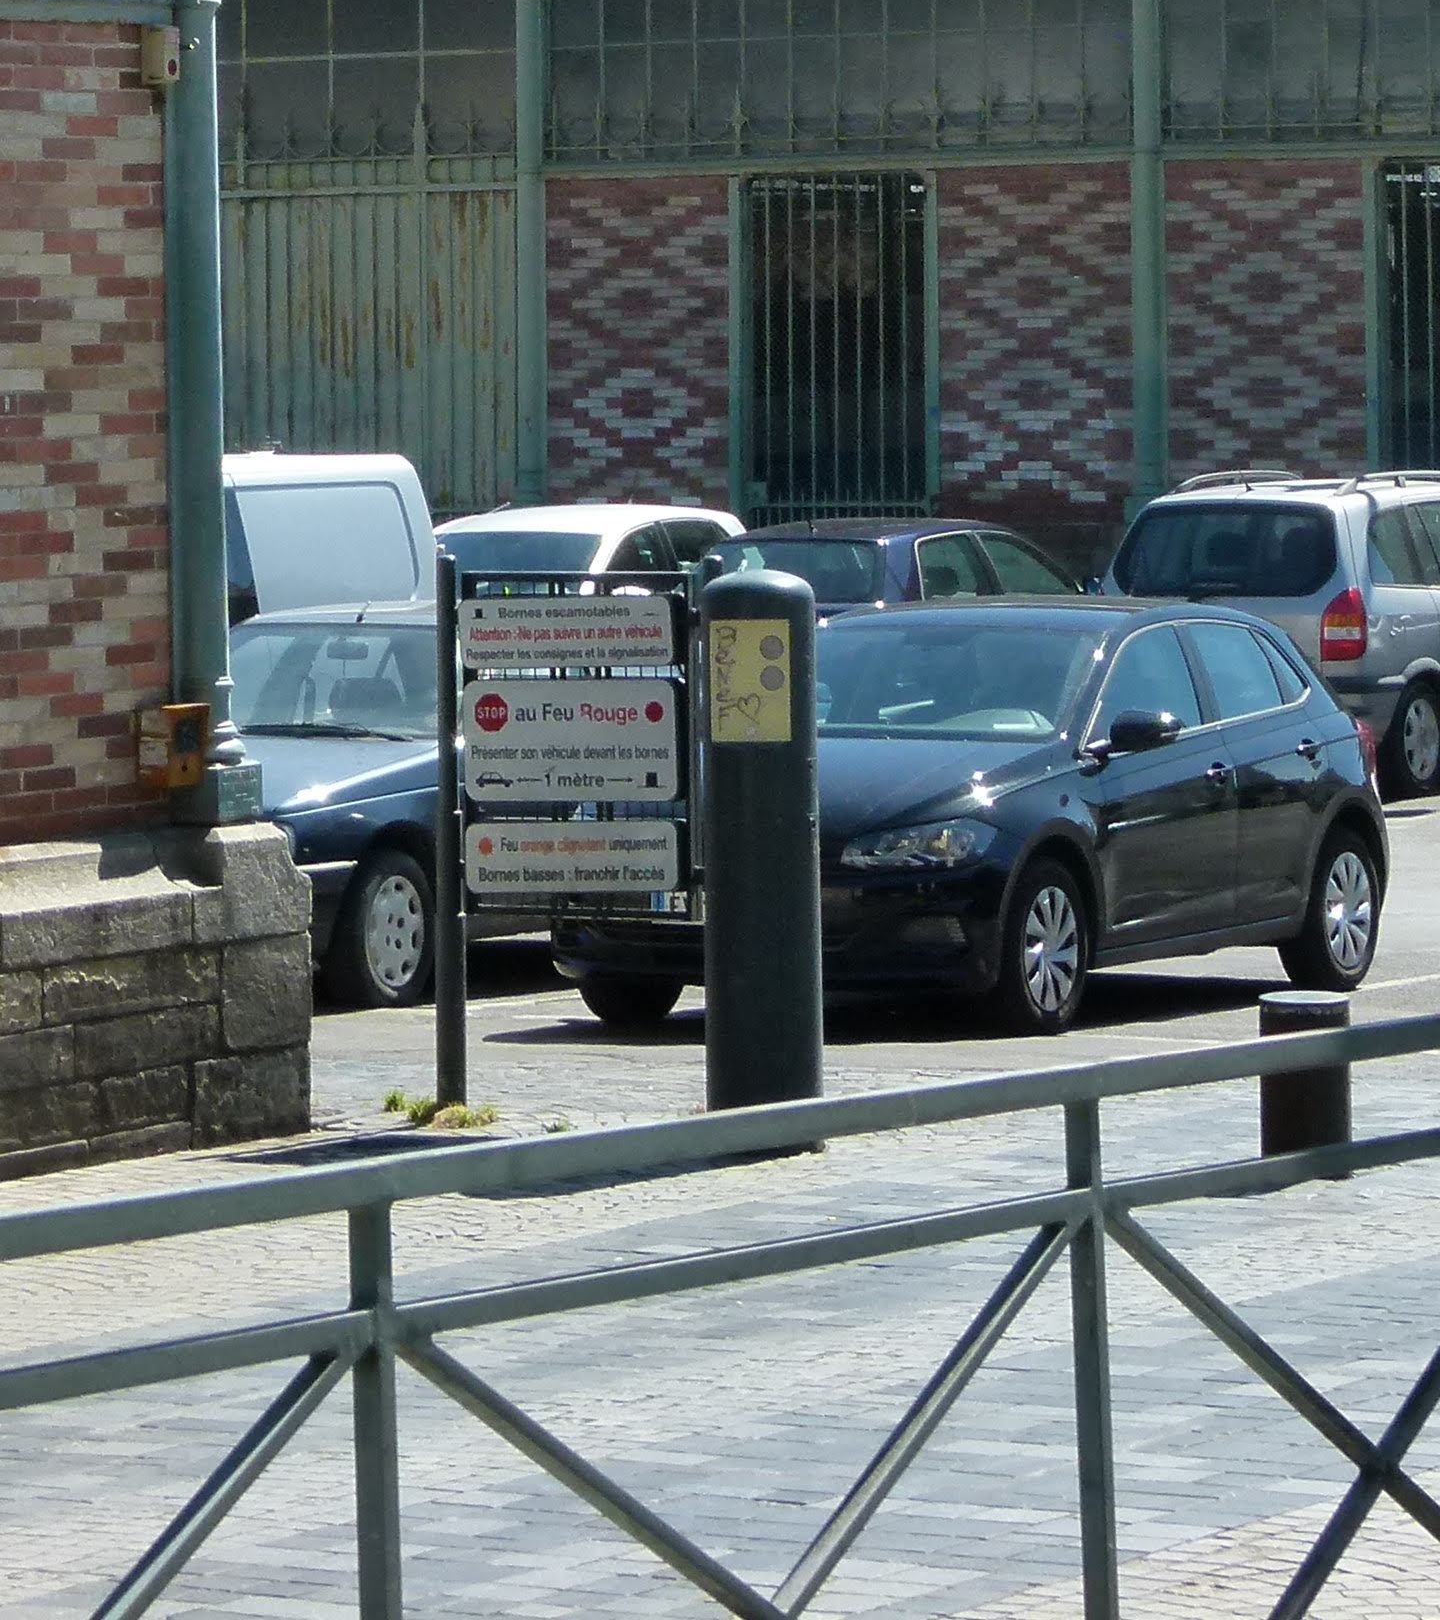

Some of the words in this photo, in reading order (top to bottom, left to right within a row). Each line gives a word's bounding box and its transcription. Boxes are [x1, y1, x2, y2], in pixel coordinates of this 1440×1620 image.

[498, 607, 542, 619] Bornes
[545, 605, 630, 618] escamotables
[534, 629, 551, 643] pas
[553, 626, 581, 640] suivre
[584, 628, 596, 639] un
[597, 625, 622, 639] autre
[466, 648, 515, 662] Respecter
[517, 648, 532, 659] les
[534, 648, 584, 662] consignes
[585, 647, 595, 658] et
[597, 646, 606, 658] la
[608, 645, 668, 661] signalisation
[477, 706, 506, 719] STOP
[515, 708, 537, 722] au
[542, 703, 574, 722] Feu
[579, 703, 638, 726] Rouge
[471, 745, 518, 760] Présenter
[521, 748, 538, 759] son
[541, 744, 580, 760] véhicule
[583, 745, 616, 759] devant
[618, 745, 632, 759] les
[634, 745, 670, 759] bornes
[557, 771, 605, 788] mètre
[500, 837, 518, 852] Feu
[520, 839, 555, 854] orange
[557, 837, 607, 855] clignotant
[609, 836, 668, 853] uniquement
[478, 867, 520, 882] Bornes
[522, 866, 565, 882] basses
[574, 866, 620, 881] franchir
[623, 866, 665, 881] l'accès
